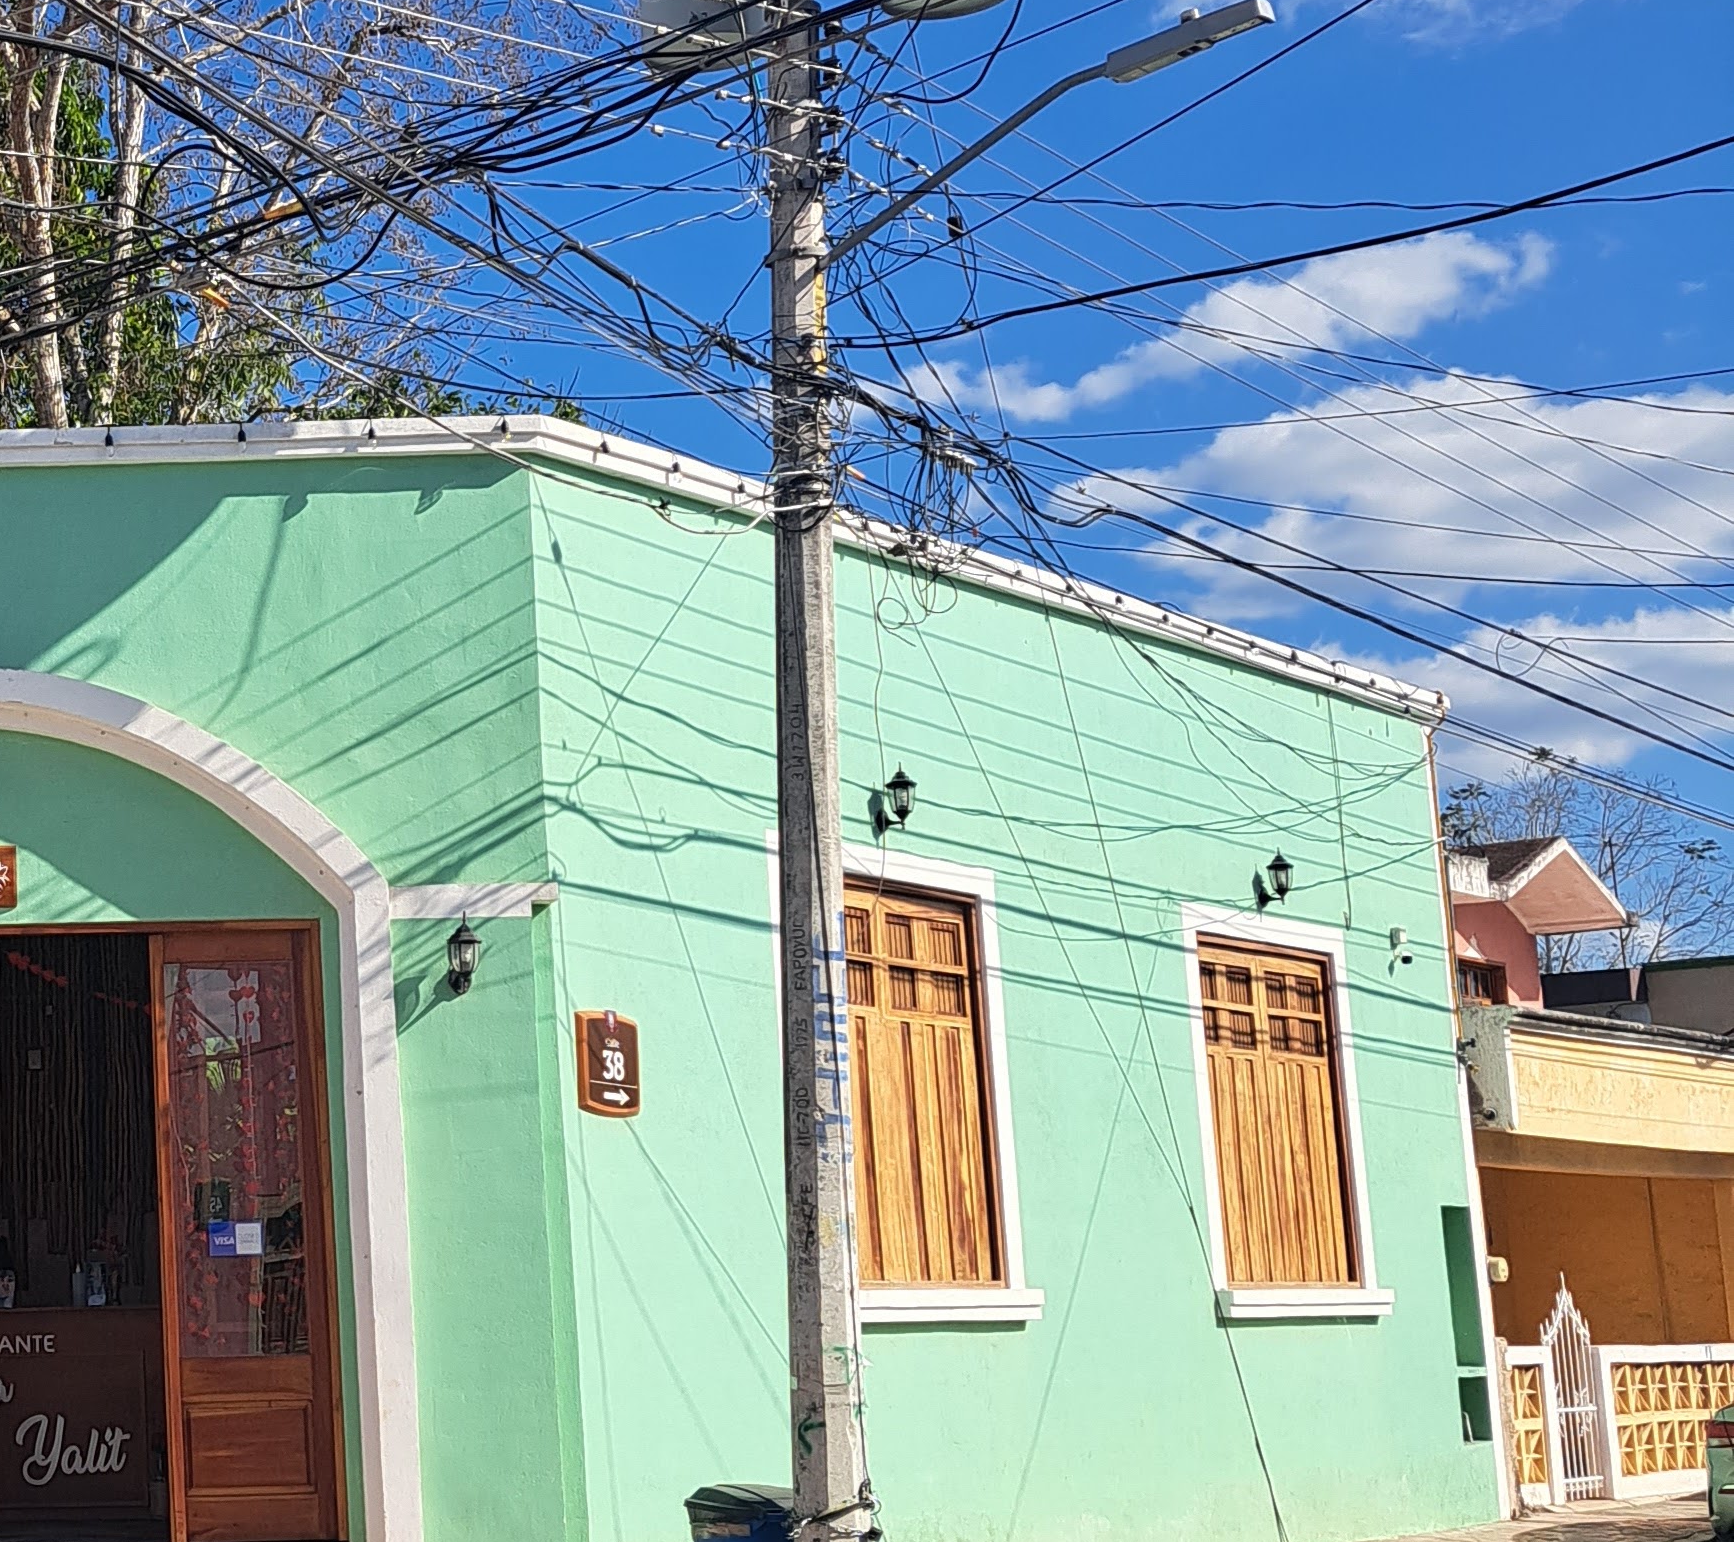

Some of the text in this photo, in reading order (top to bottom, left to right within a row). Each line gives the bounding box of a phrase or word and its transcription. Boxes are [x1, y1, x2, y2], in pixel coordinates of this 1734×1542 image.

[602, 1049, 625, 1081] 38
[213, 1236, 235, 1246] VISA
[15, 1413, 131, 1486] Yalit
